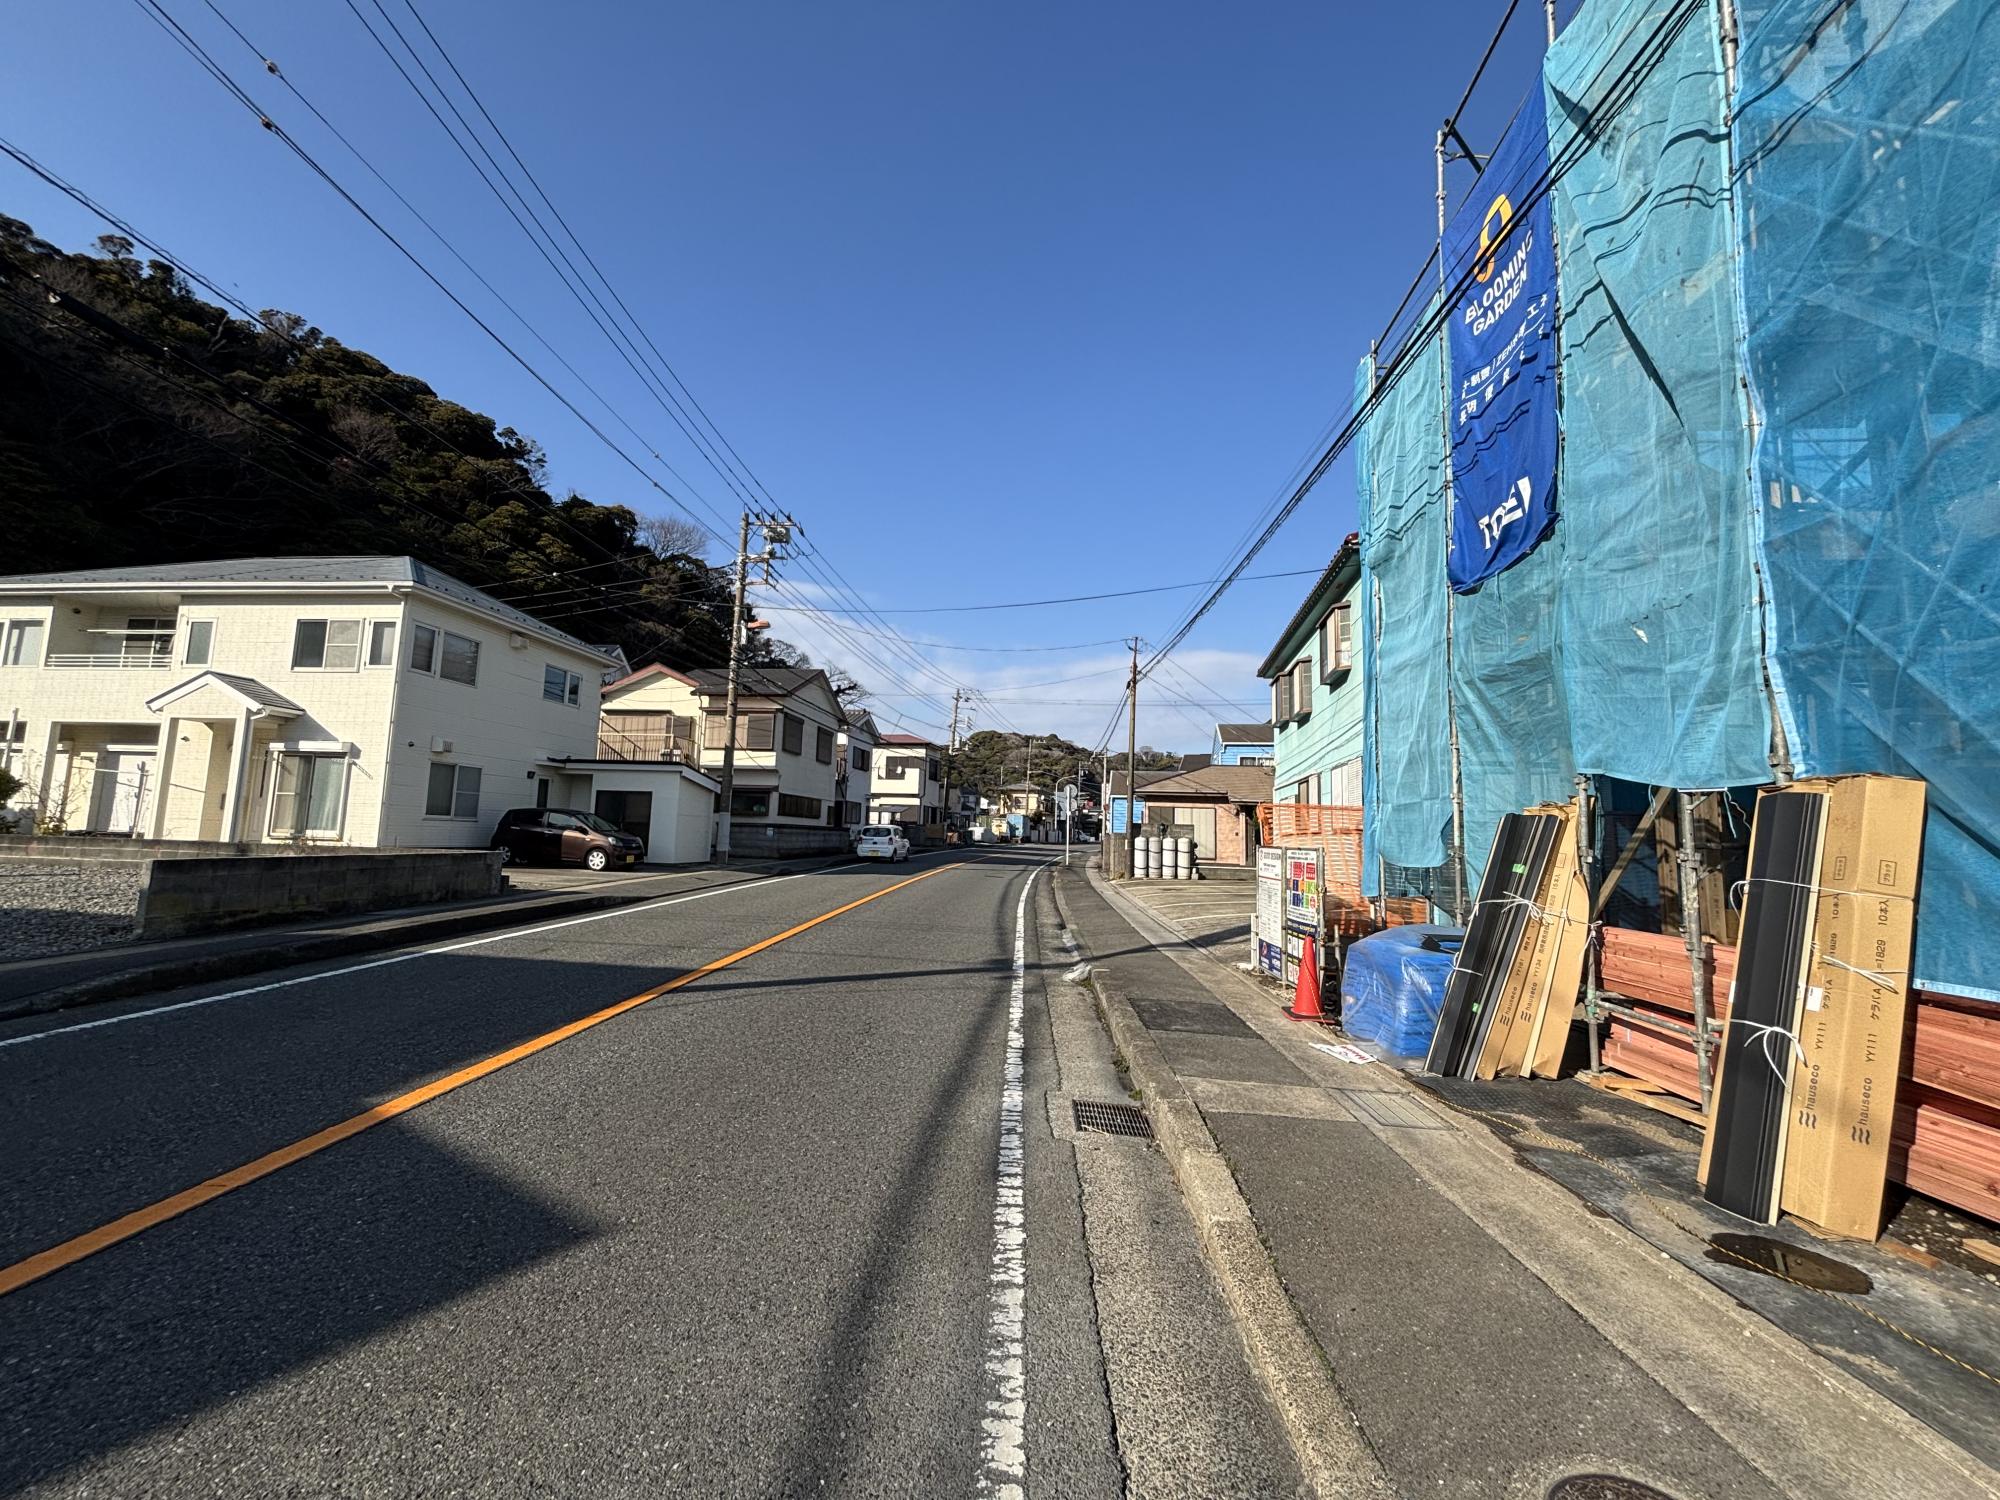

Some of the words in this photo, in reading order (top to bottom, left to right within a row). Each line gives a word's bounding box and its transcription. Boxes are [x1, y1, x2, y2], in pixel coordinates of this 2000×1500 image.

[1465, 229, 1533, 325] BLOOMING
[1473, 262, 1527, 336] GARDEN
[1878, 899, 1889, 926] 10本入
[1875, 939, 1887, 971] =1829
[1804, 1064, 1820, 1111] hauseco
[1815, 1022, 1827, 1051] YY111
[1865, 1033, 1878, 1063] YY111
[1857, 1077, 1873, 1126] hauseco
